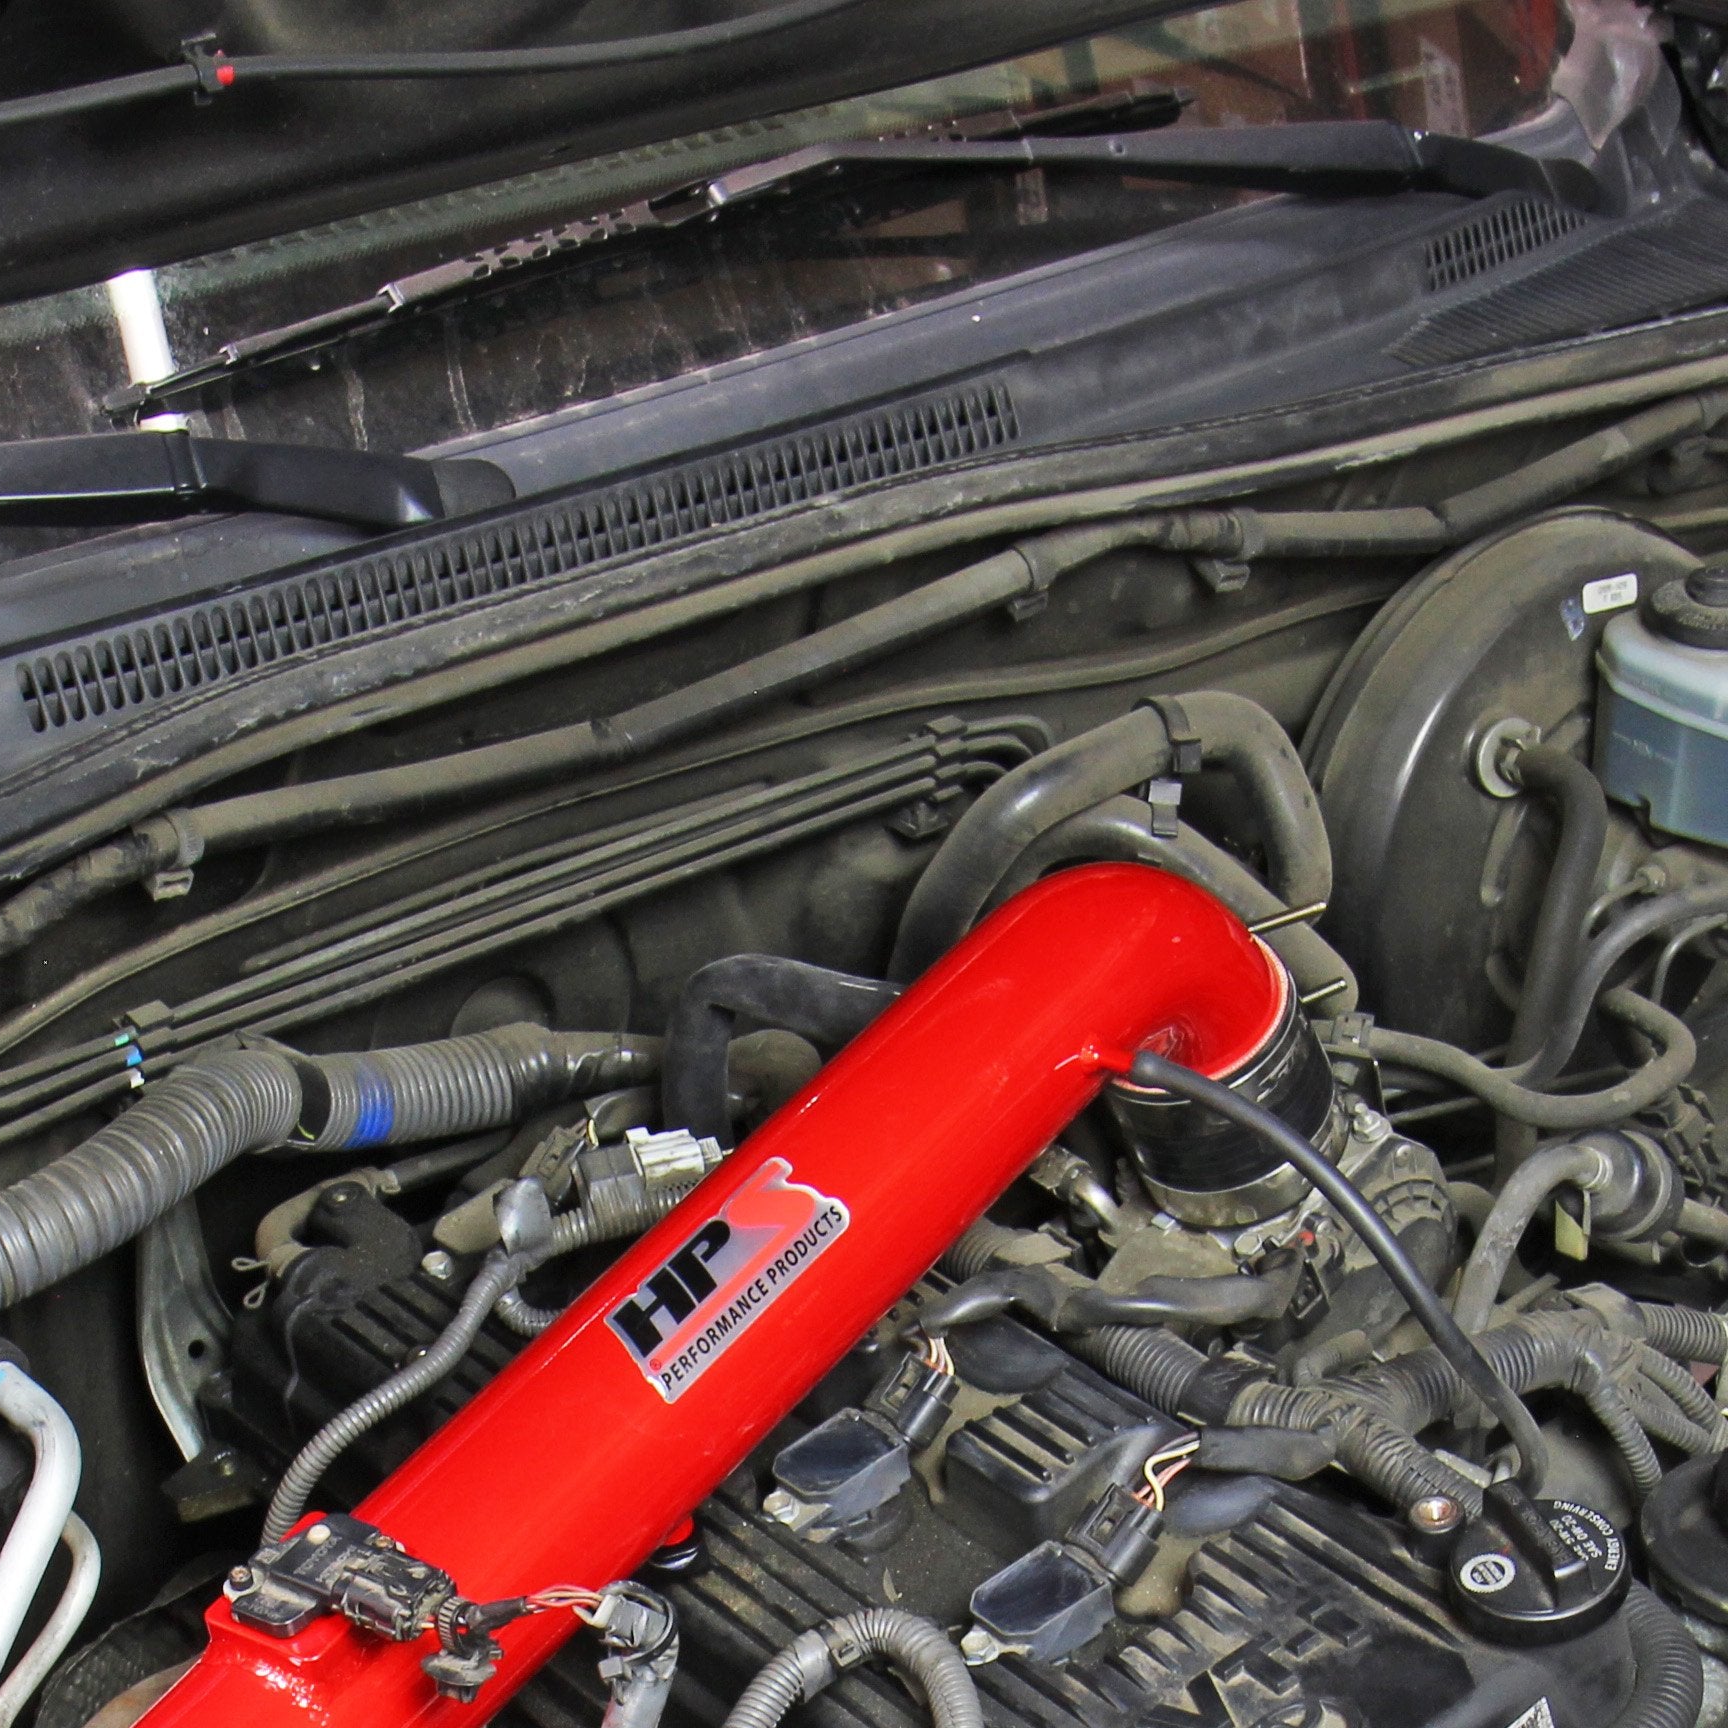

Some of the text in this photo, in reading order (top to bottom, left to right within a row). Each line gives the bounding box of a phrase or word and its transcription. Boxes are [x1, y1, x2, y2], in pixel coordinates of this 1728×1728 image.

[613, 1158, 817, 1368] HPS
[660, 1205, 843, 1392] PERFORMANCE PRODUCTS
[1553, 1500, 1614, 1537] CONSERVING
